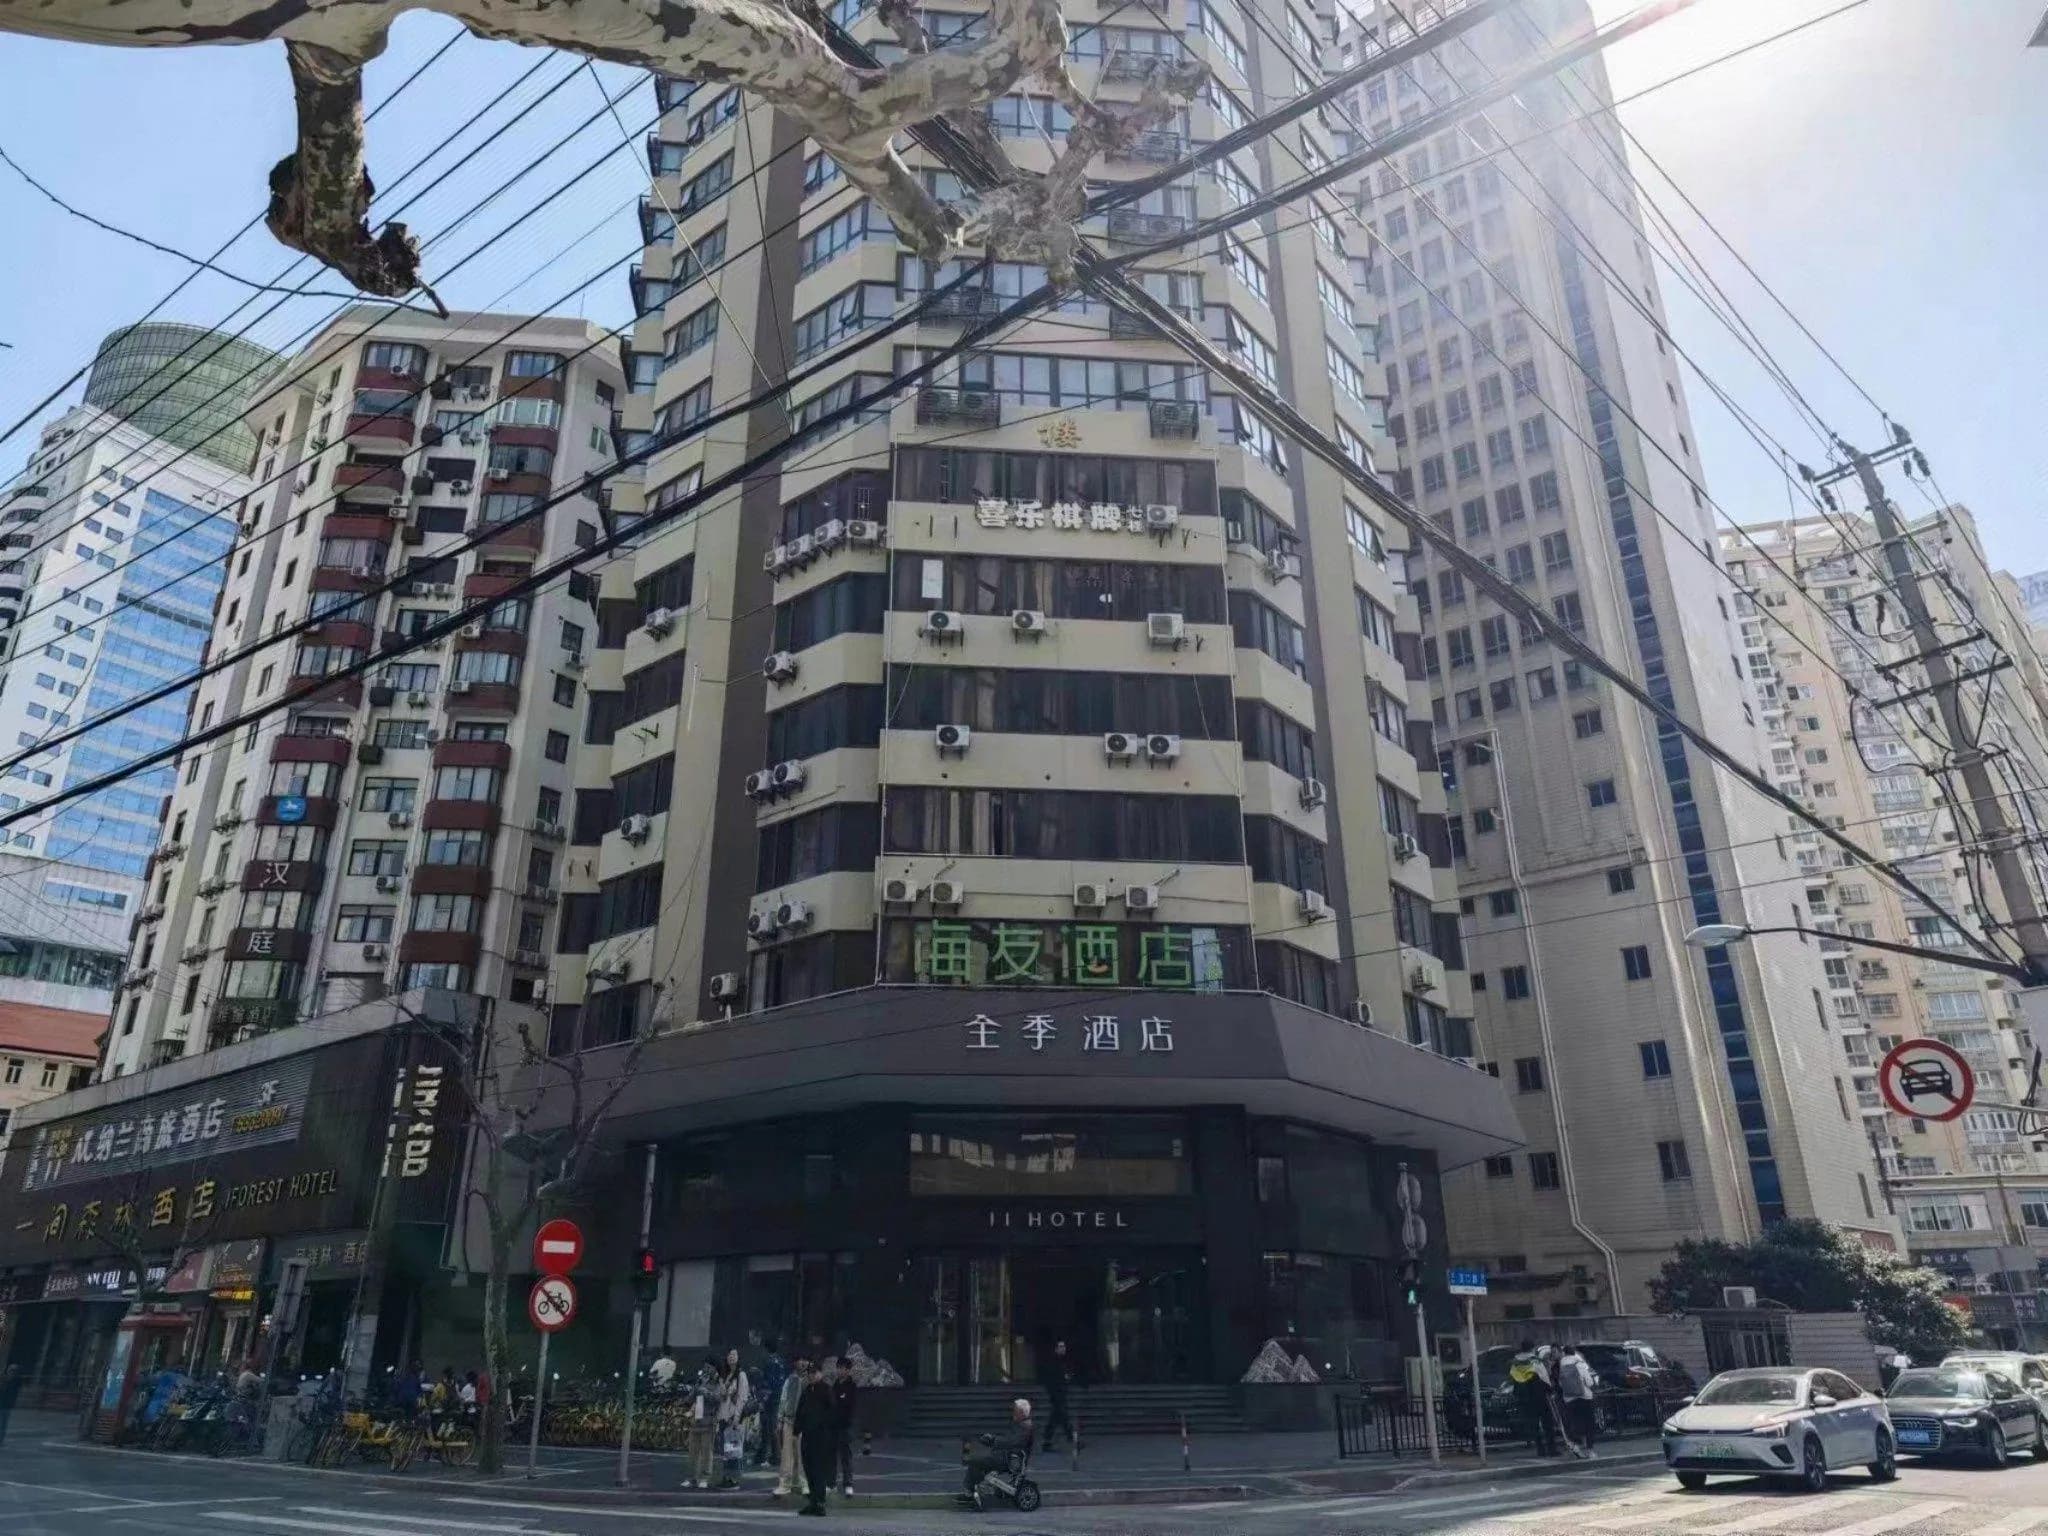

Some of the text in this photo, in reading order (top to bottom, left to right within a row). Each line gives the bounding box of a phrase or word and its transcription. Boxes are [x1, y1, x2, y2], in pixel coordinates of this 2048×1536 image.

[246, 862, 290, 954] 汉庭
[916, 919, 1193, 987] 海友酒店
[964, 1013, 1174, 1052] 全季酒店
[290, 1169, 337, 1198] HOTEL
[1028, 1211, 1129, 1228] HOTEL
